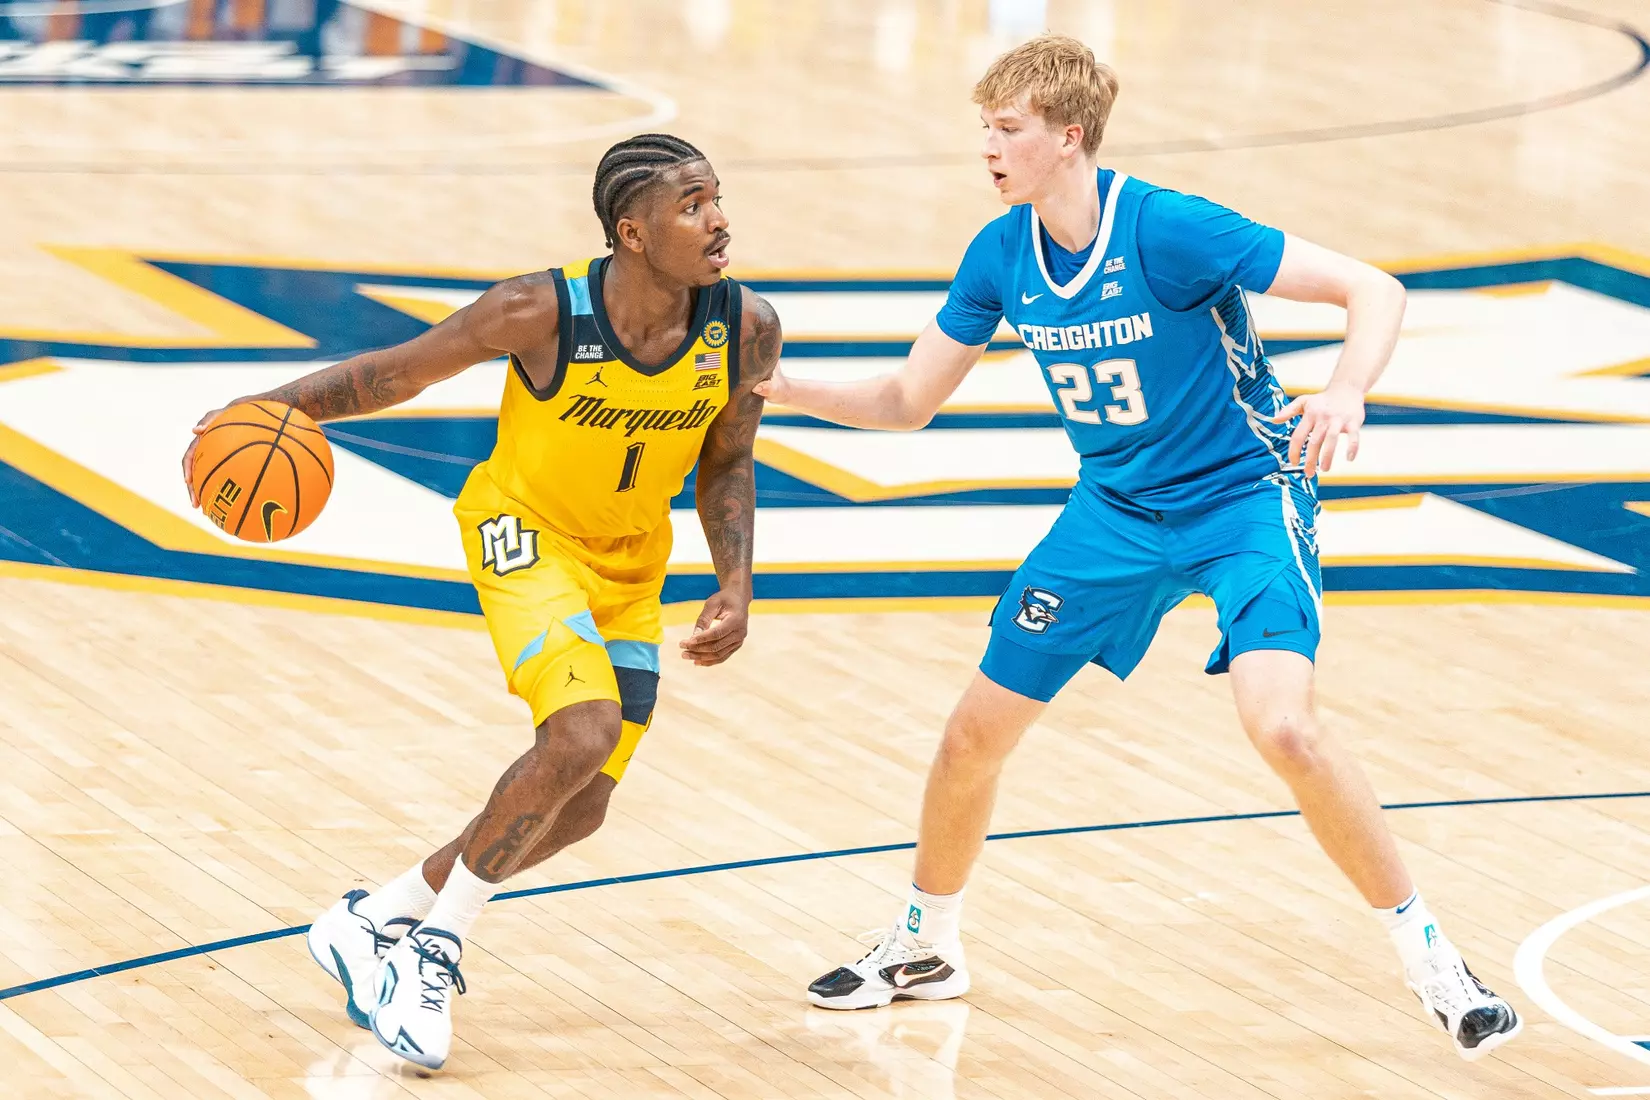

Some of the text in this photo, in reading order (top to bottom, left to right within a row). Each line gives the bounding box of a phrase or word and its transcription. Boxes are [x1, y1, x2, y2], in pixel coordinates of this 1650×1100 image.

[1018, 312, 1153, 351] CREIGHTON
[695, 379, 722, 389] EAST
[699, 373, 717, 381] BIG
[1046, 358, 1149, 426] 23
[558, 394, 718, 437] Marquette
[615, 441, 646, 492] 1
[477, 514, 540, 577] MU
